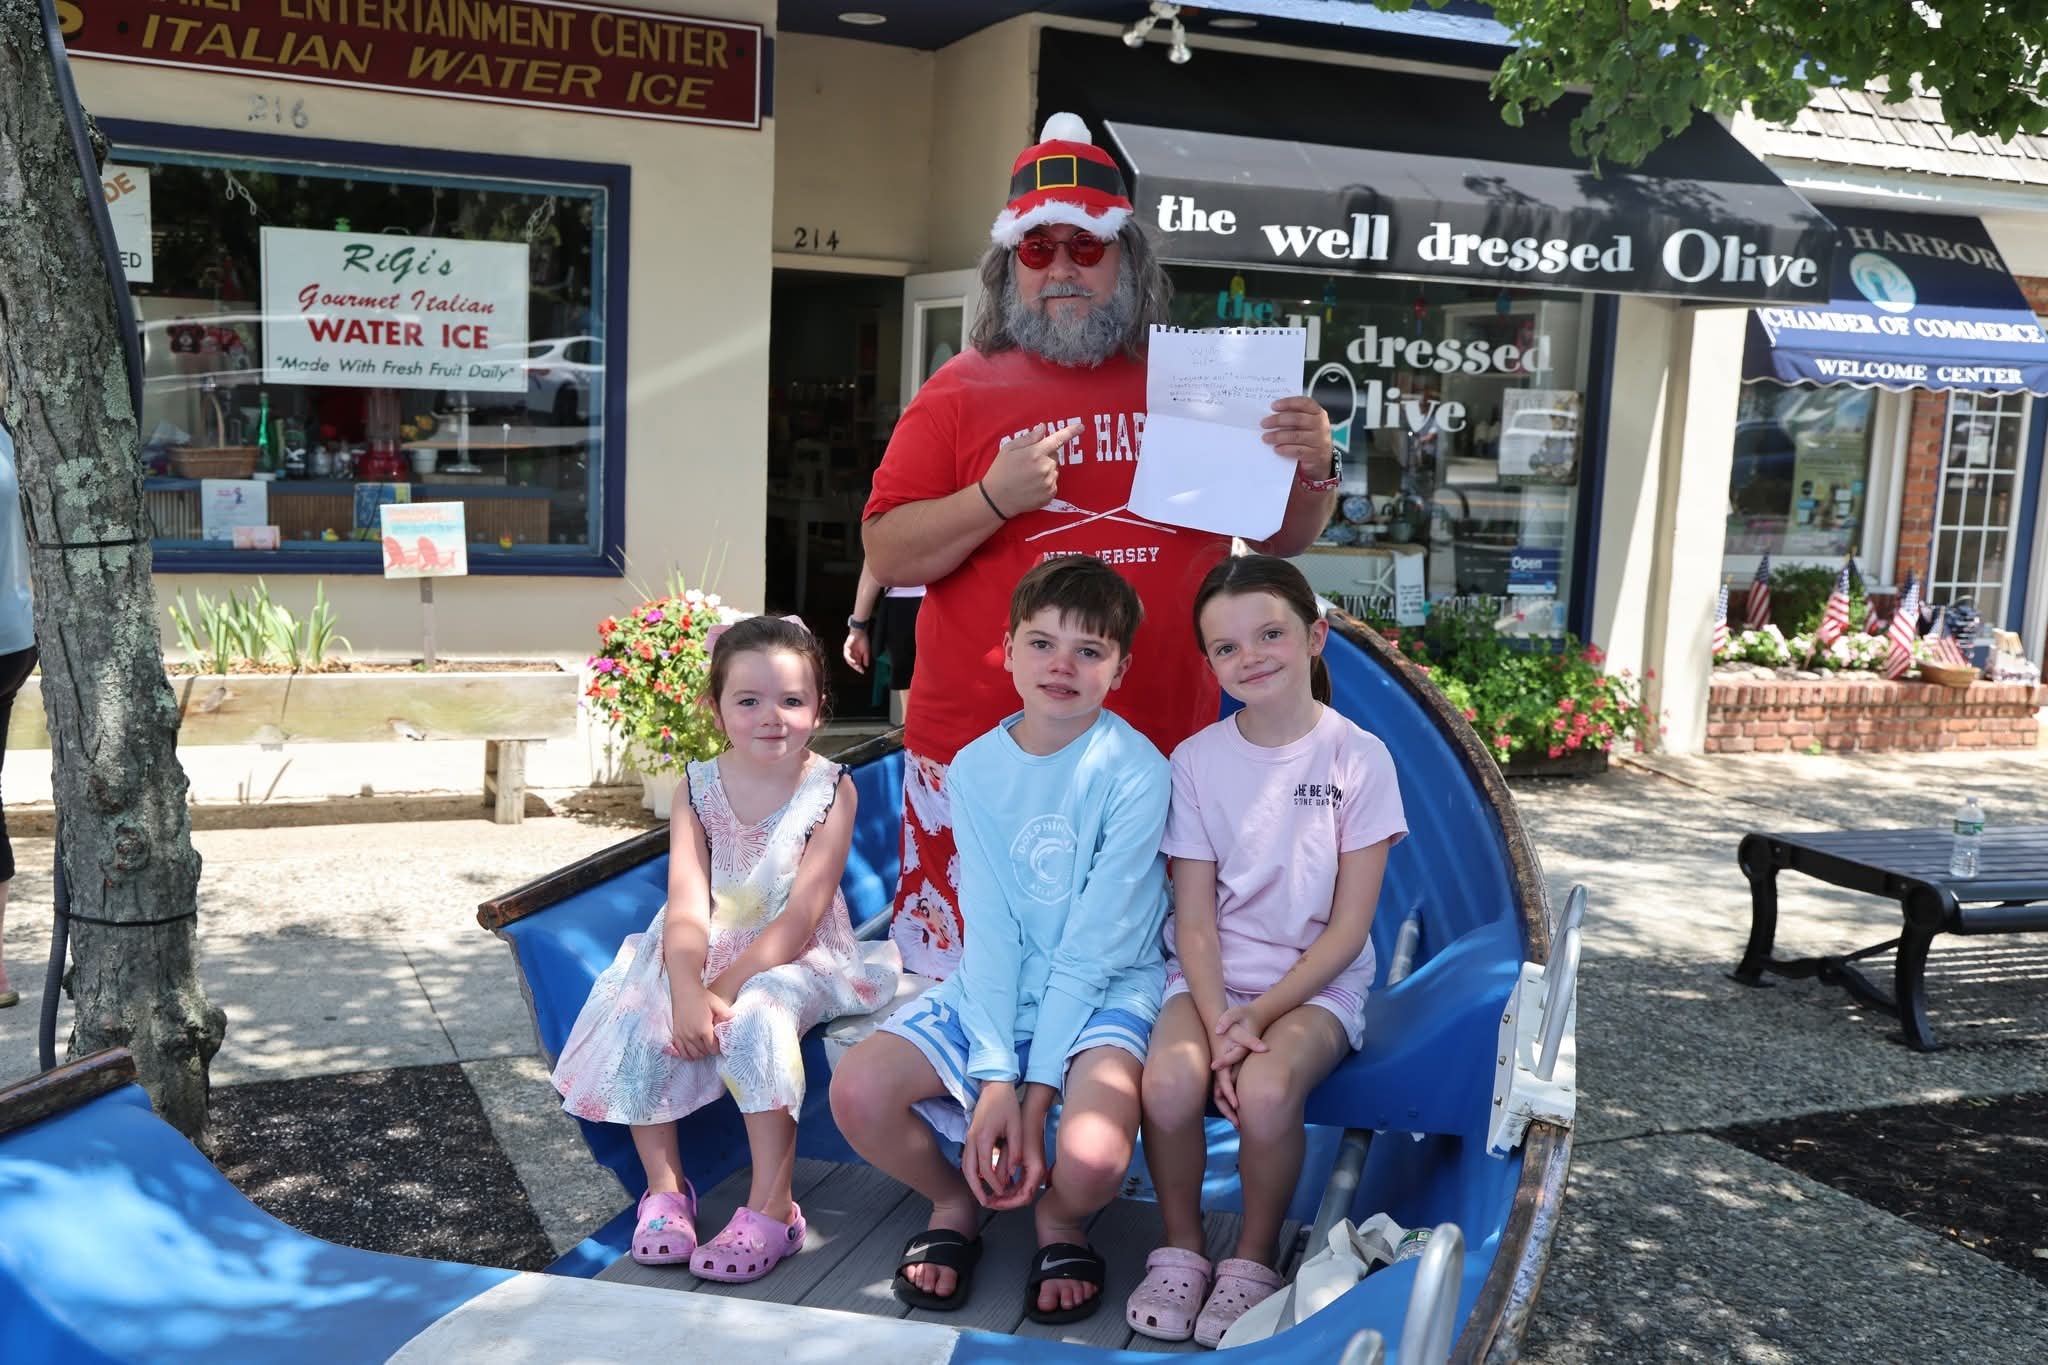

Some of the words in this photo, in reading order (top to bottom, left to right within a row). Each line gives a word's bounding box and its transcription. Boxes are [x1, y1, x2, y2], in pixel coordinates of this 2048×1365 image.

[591, 13, 729, 69] CENTER
[142, 14, 373, 75] ITALIAN
[407, 46, 602, 98] WATER
[626, 71, 714, 109] ICE
[248, 95, 309, 128] 216
[794, 226, 840, 251] 214
[1157, 194, 1237, 235] the
[1260, 212, 1390, 262] well
[1417, 222, 1635, 274] dressed
[1662, 228, 1818, 288] Olive
[1845, 225, 2006, 273] HARBOR
[298, 283, 400, 313] Gourmet
[410, 289, 496, 315] Italian
[1216, 291, 1274, 323] the
[307, 317, 424, 347] WATER
[442, 323, 489, 349] ICE
[1765, 307, 1880, 334] CHAMBER
[1879, 317, 1910, 336] OF
[1913, 318, 2046, 344] COMMERCE
[1346, 325, 1554, 376] dressed
[339, 358, 376, 374] With
[382, 360, 423, 377] Fresh
[429, 361, 463, 378] Fruit
[1815, 358, 1928, 380] WELCOME
[1937, 366, 2023, 384] CENTER
[1511, 556, 1543, 571] Open
[1310, 784, 1322, 797] BE
[1017, 820, 1066, 855] DOLPHIN
